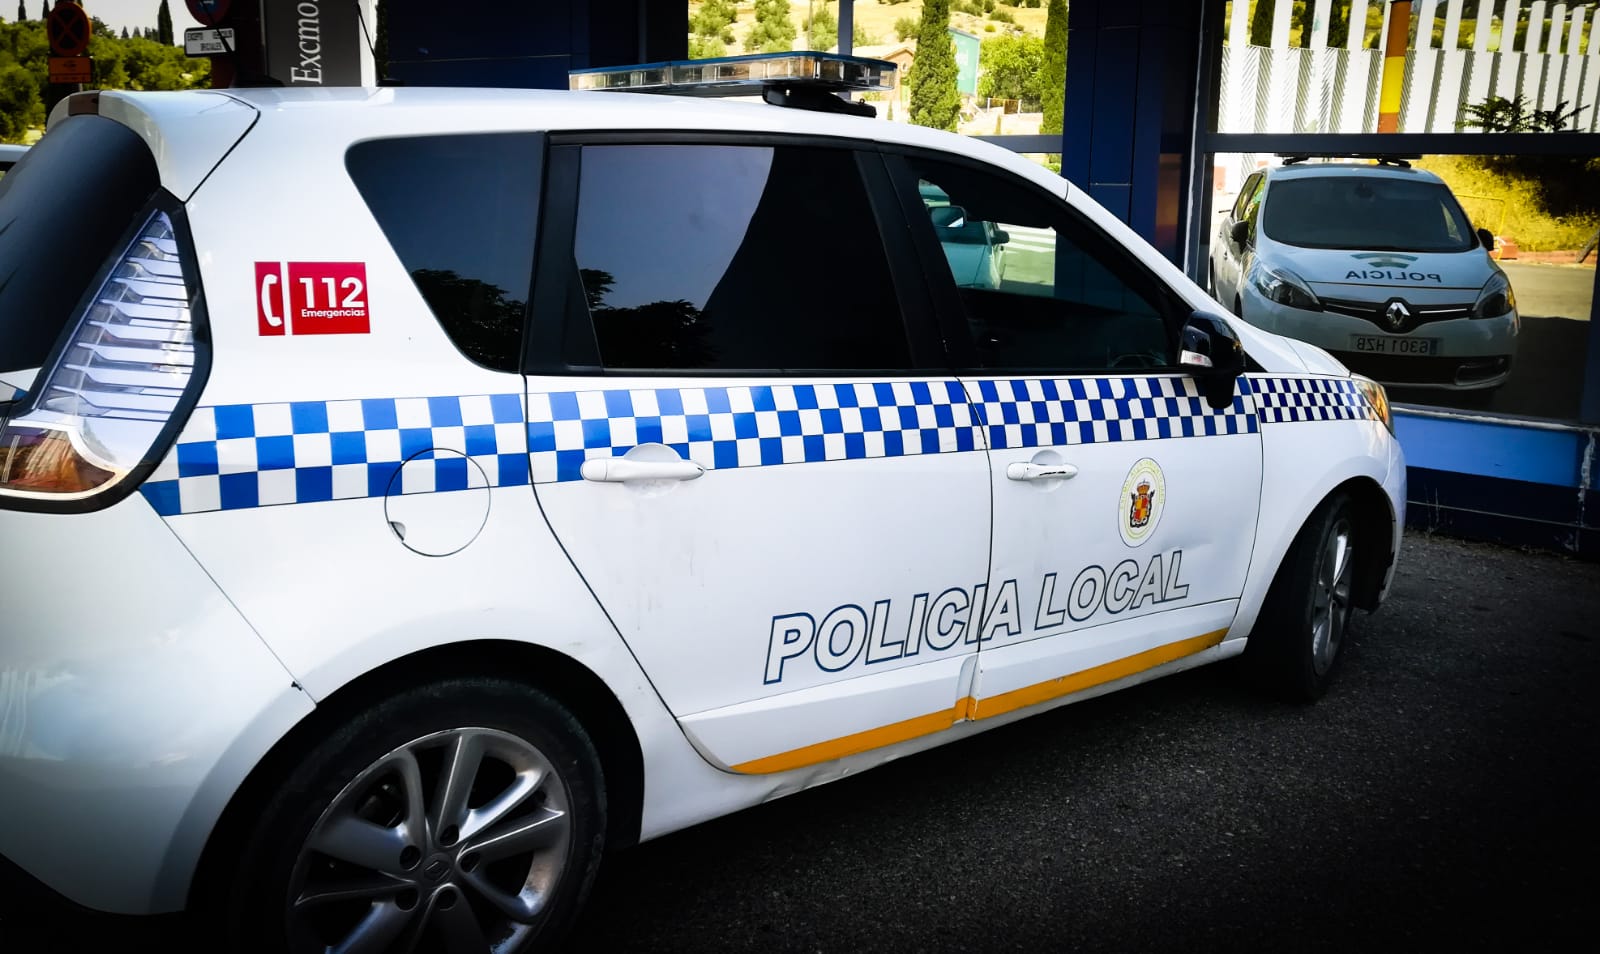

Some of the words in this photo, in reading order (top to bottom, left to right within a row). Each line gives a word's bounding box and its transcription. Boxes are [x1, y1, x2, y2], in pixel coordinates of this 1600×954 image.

[299, 277, 364, 308] 112
[301, 308, 365, 318] Emergencias
[763, 579, 1021, 685] POLICIA
[1035, 550, 1190, 629] LOCAL
